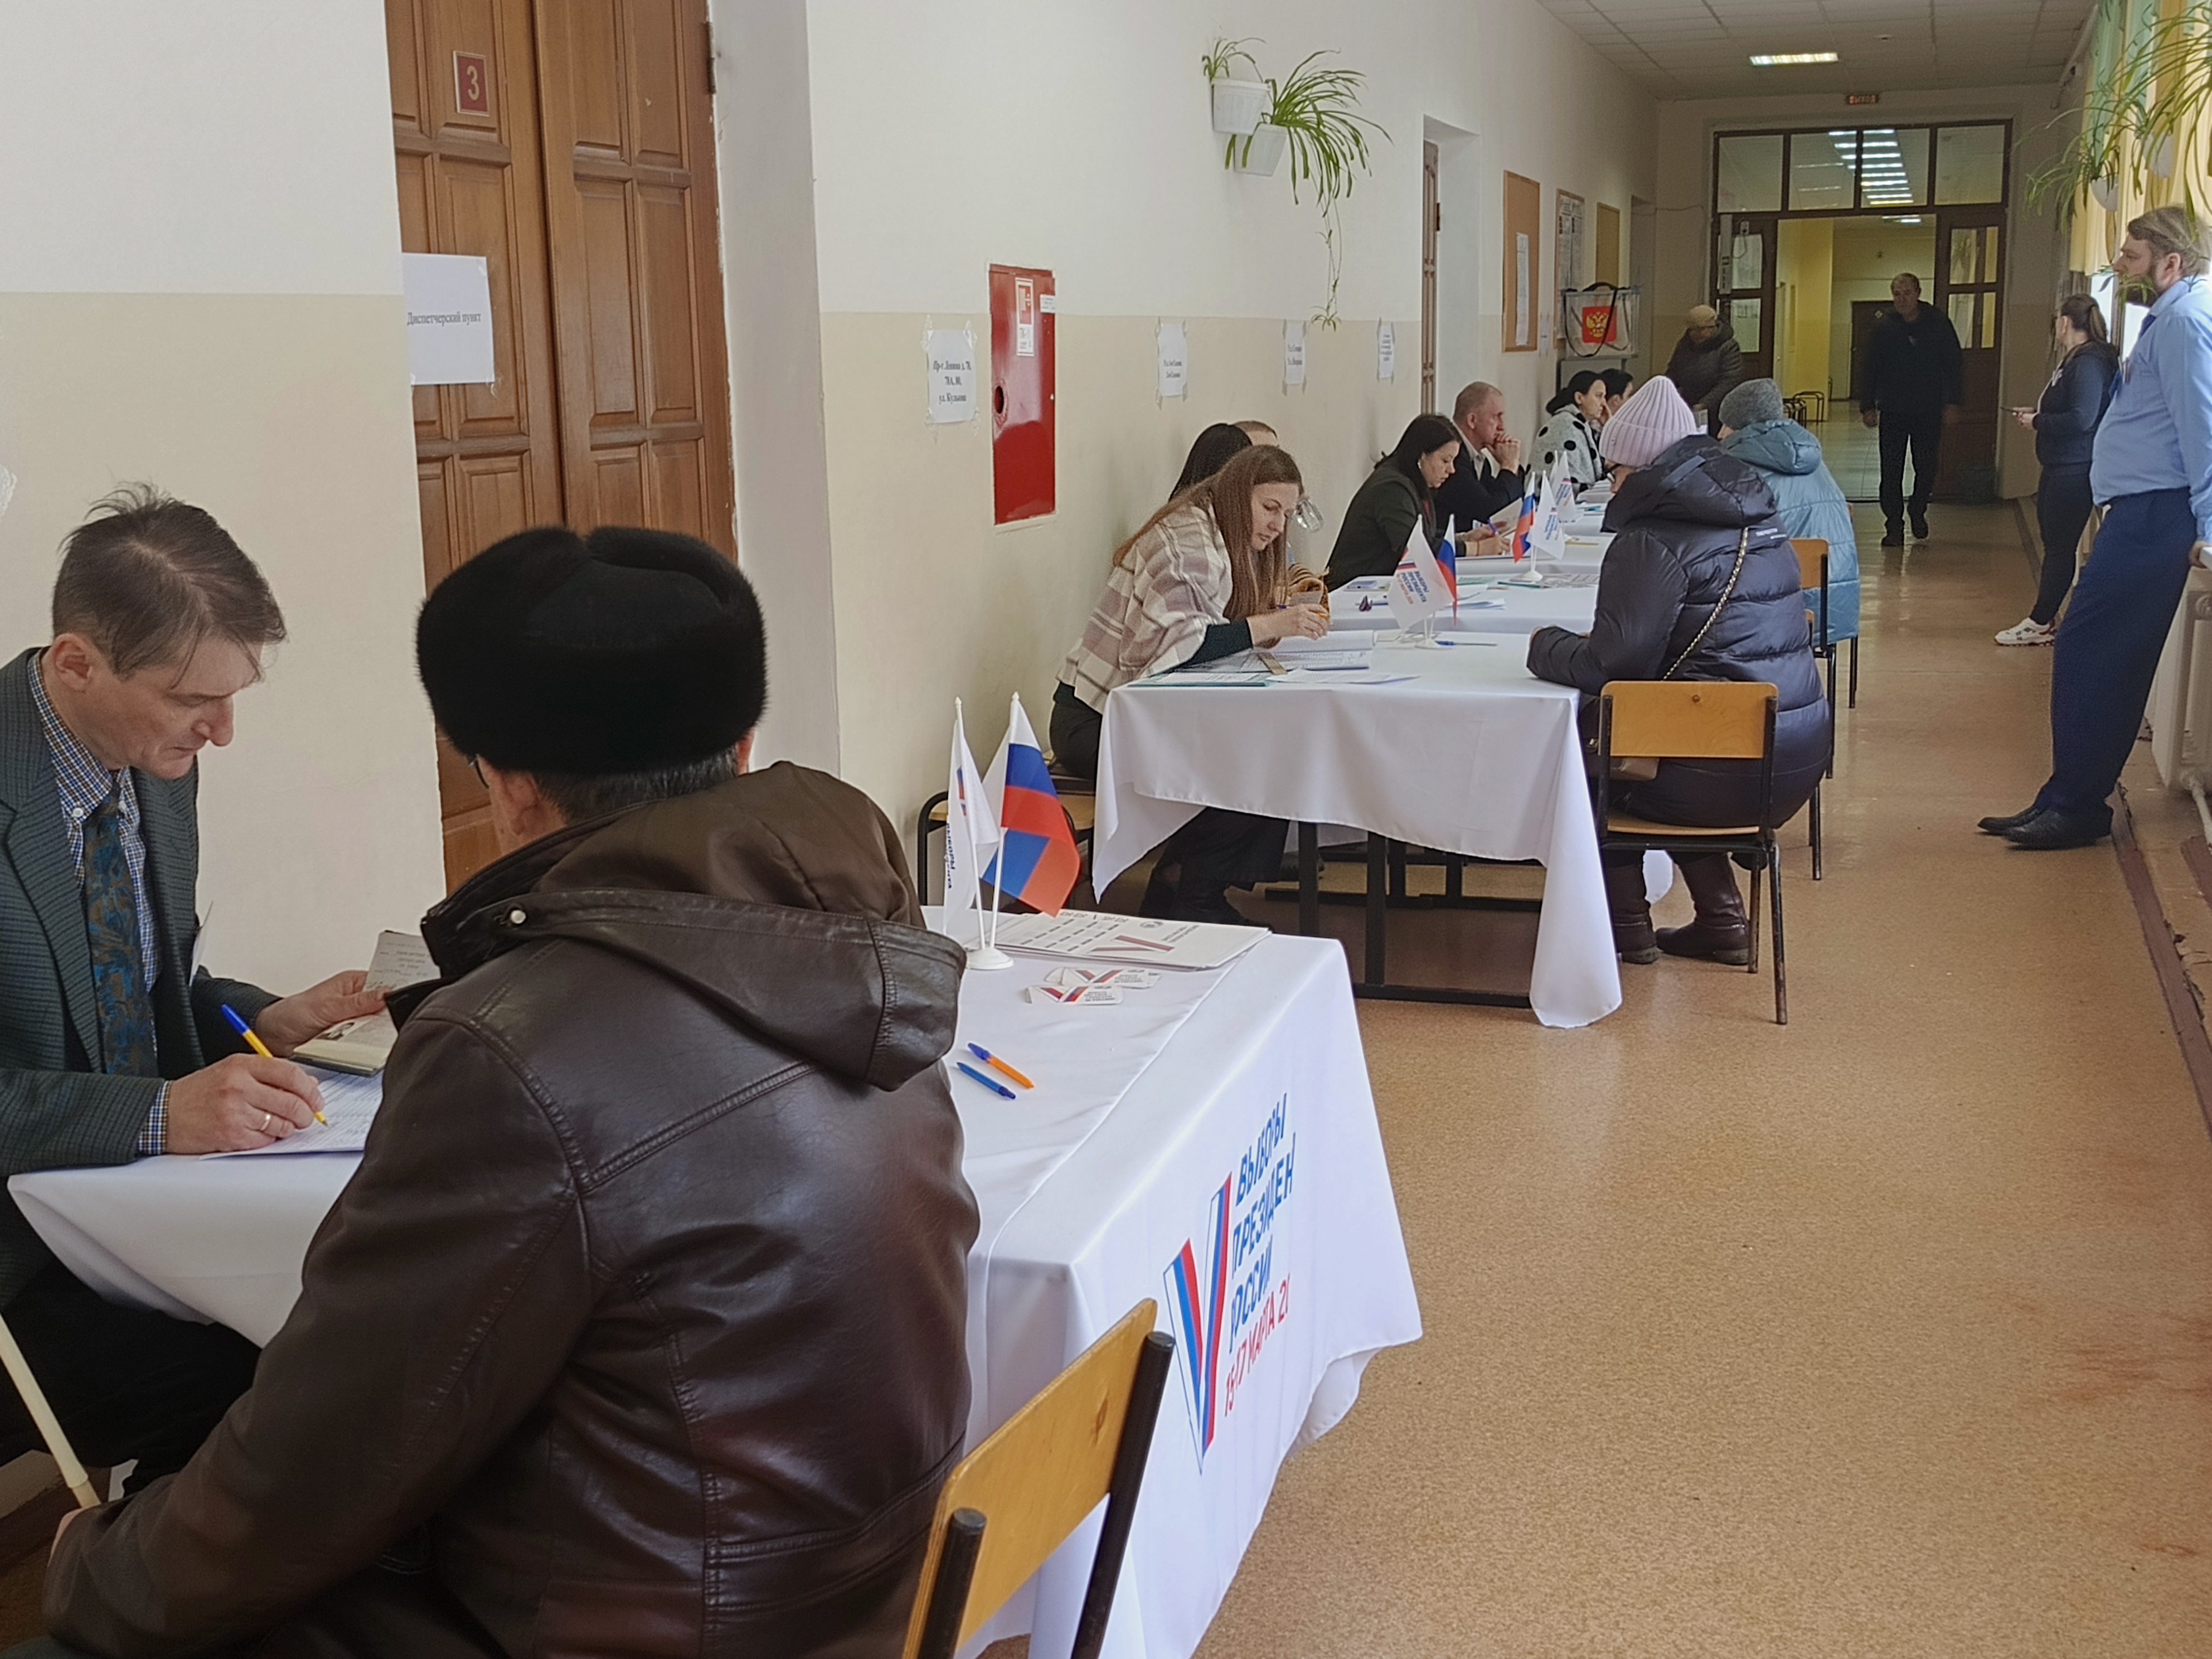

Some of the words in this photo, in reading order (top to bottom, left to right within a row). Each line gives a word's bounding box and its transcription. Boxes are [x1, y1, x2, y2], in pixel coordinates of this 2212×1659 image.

[467, 65, 480, 101] 3
[407, 311, 461, 327] Диспетчерский
[462, 313, 481, 326] пункт
[1235, 1092, 1287, 1207] ВЫБОРЫ
[1232, 1131, 1296, 1279] ПРЕЗИДЕН
